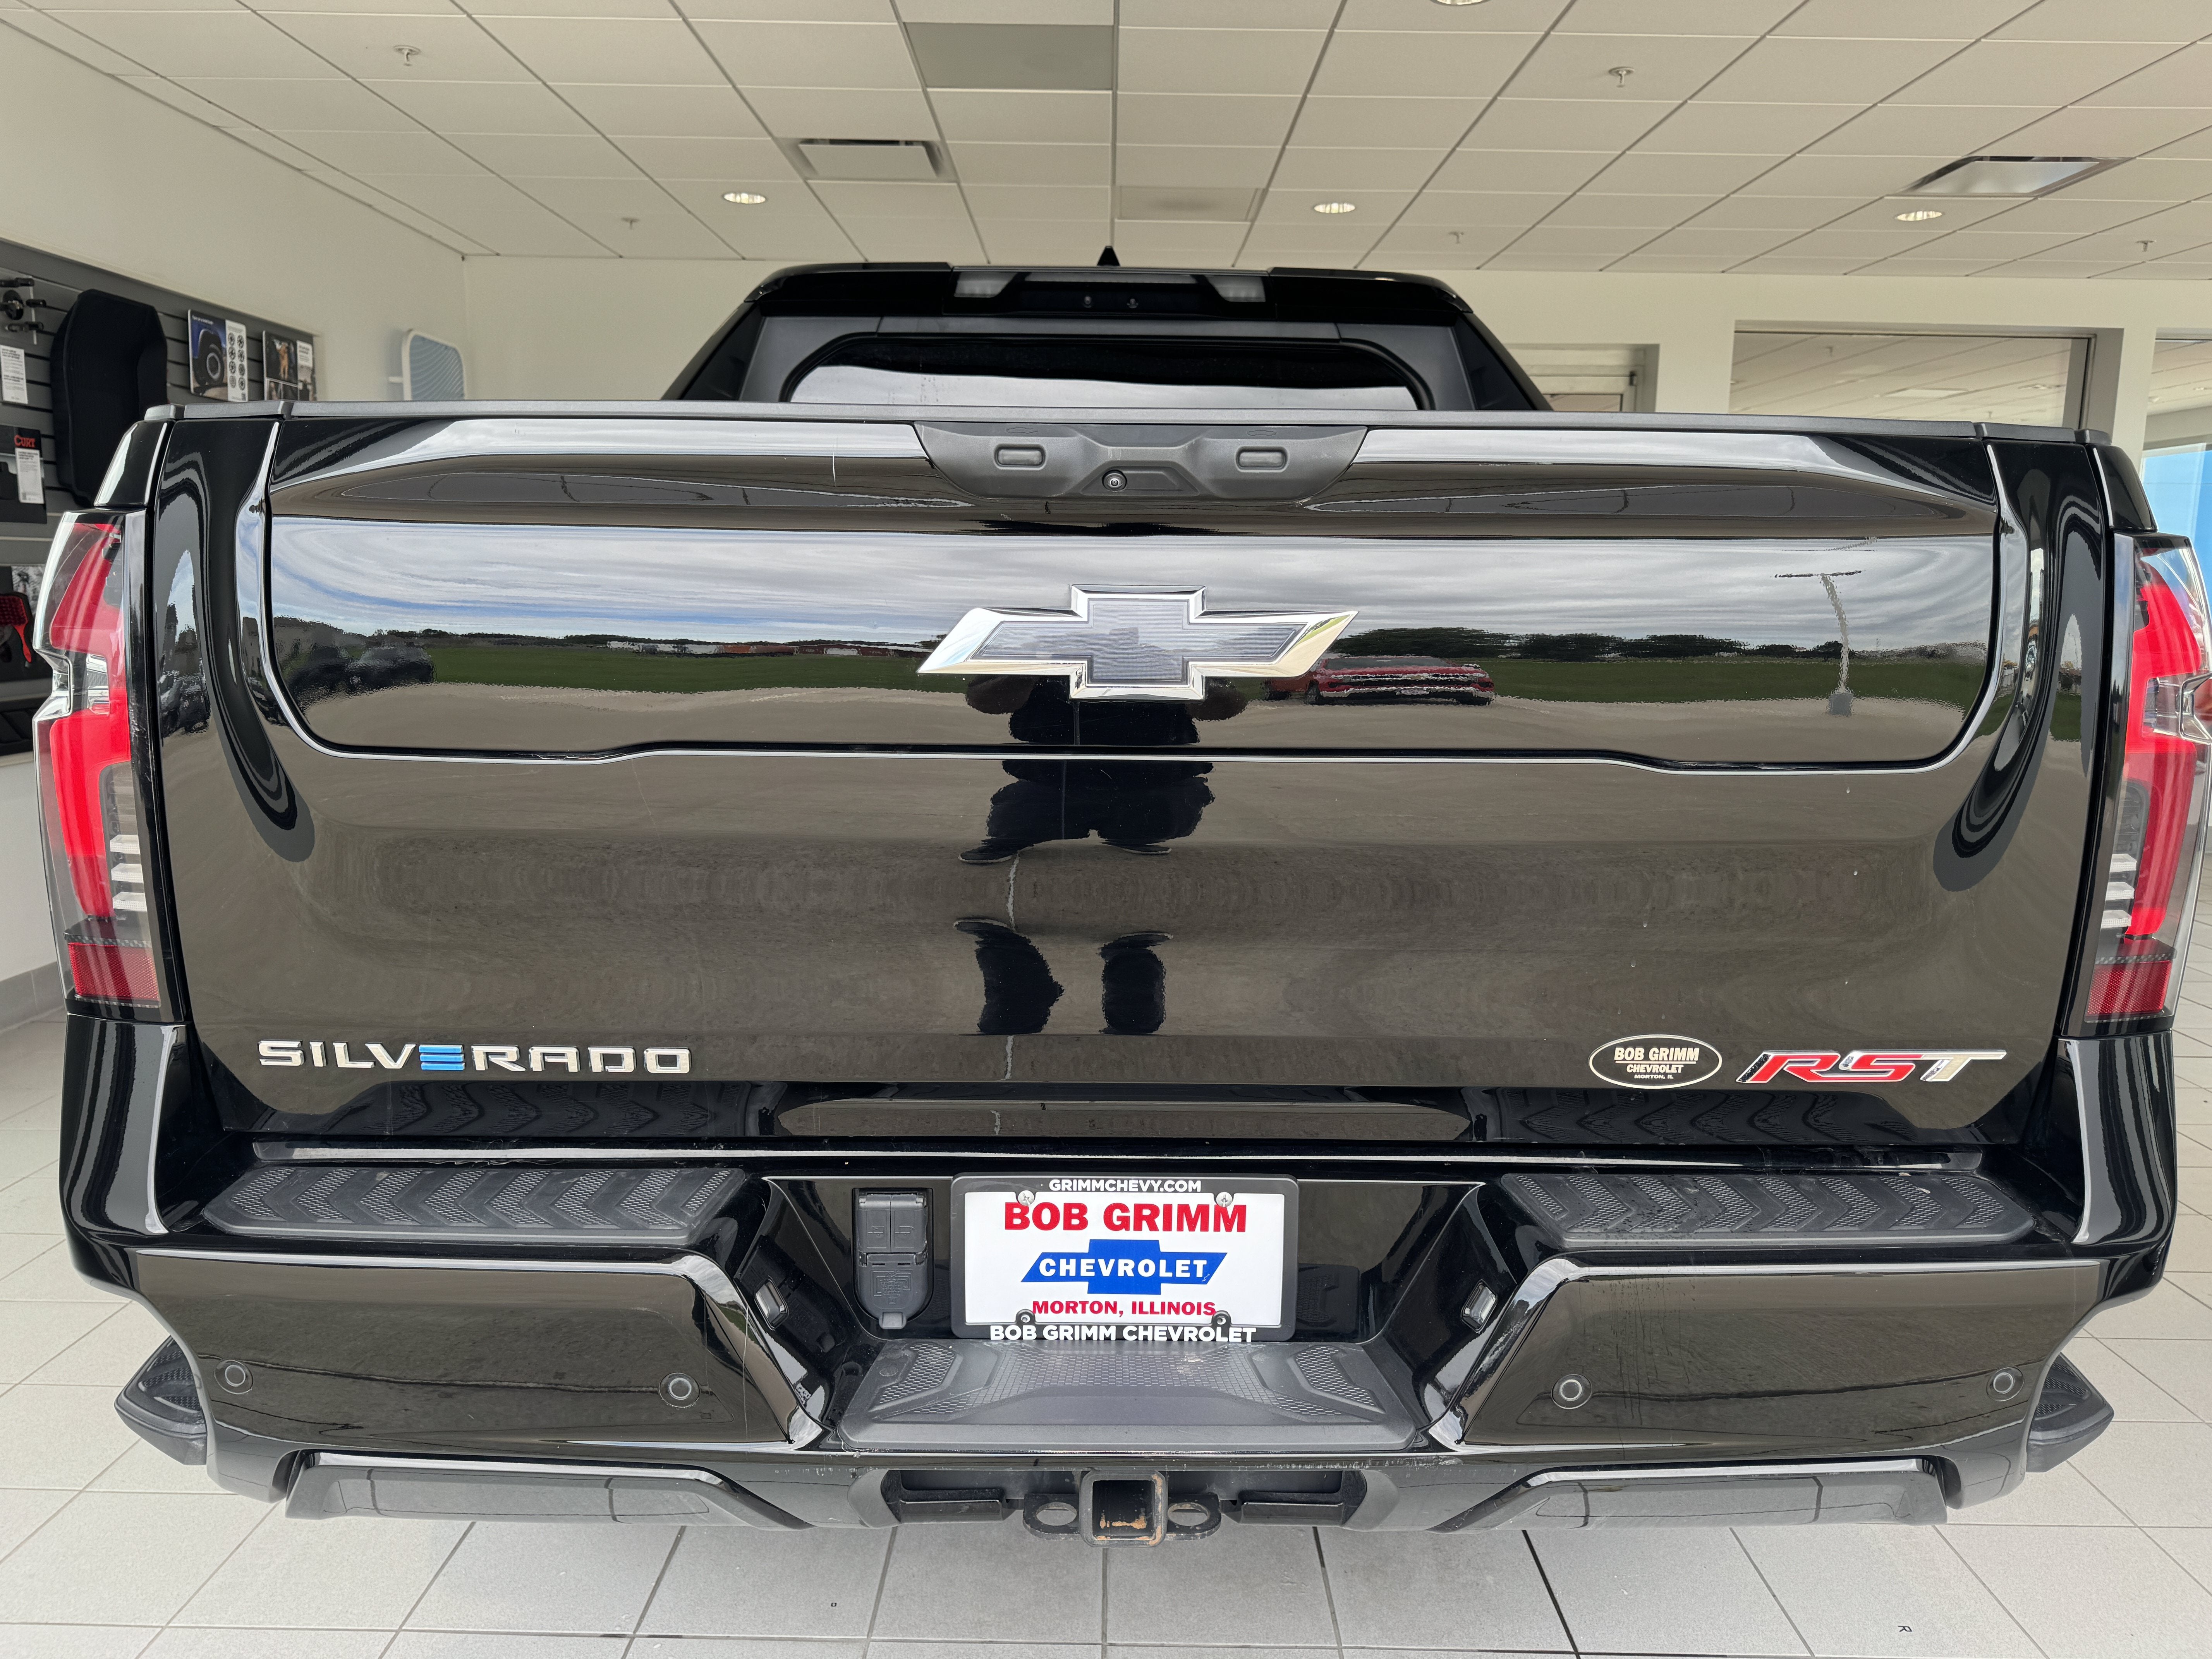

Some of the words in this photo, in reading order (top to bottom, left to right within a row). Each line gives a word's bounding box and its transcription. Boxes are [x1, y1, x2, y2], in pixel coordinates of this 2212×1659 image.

[258, 1040, 692, 1074] SILVERADO
[1614, 1047, 1644, 1061] BOB
[1648, 1047, 1700, 1061] GRIMM
[1626, 1064, 1684, 1073] CHEVROLET
[1736, 1049, 2007, 1083] RST
[1049, 1179, 1201, 1192] GRIMMCHEVY.COM
[1005, 1202, 1088, 1230] BOB
[1103, 1203, 1246, 1232] GRIMM
[1039, 1258, 1207, 1278] CHEVROLET
[1032, 1300, 1124, 1317] MORTON,
[1131, 1301, 1216, 1316] ILLINOIS
[990, 1325, 1037, 1340] BOB
[1042, 1325, 1116, 1341] GRIMM
[1122, 1326, 1256, 1343] CHEVROLET
